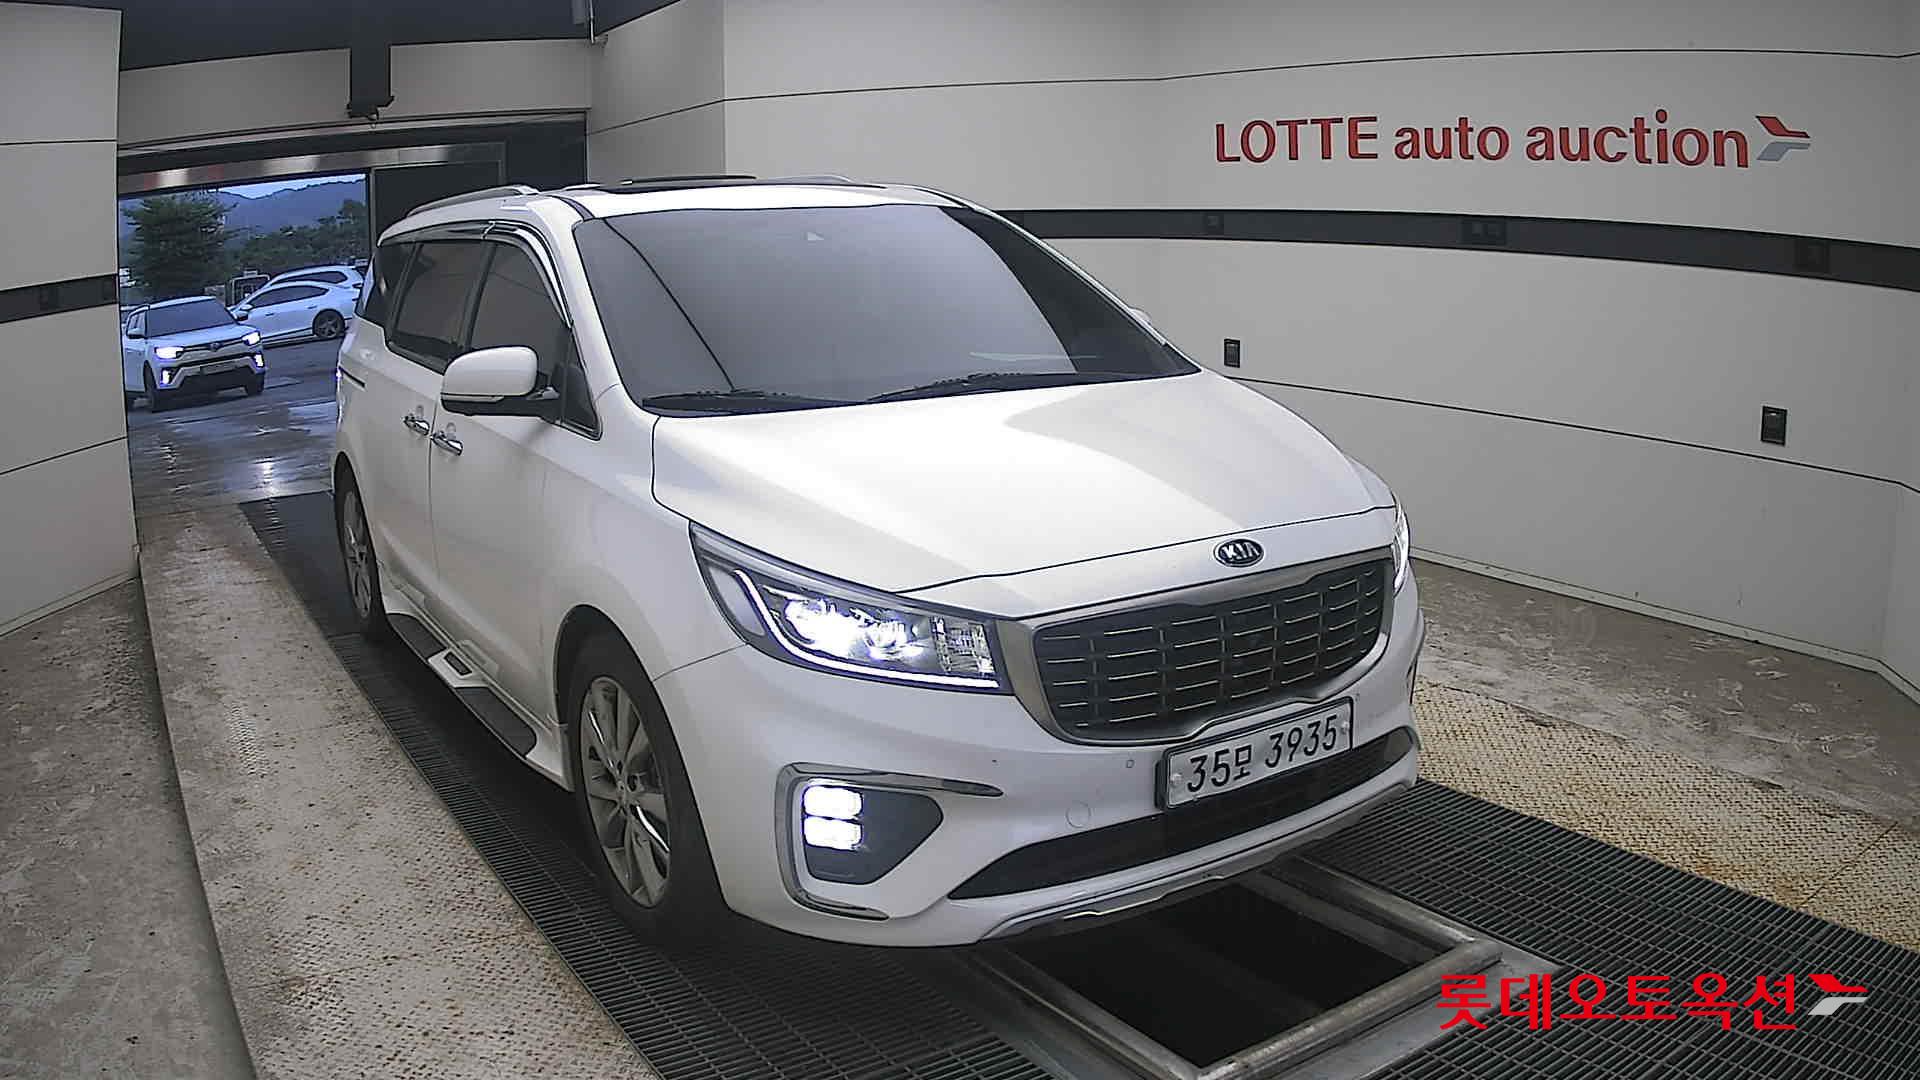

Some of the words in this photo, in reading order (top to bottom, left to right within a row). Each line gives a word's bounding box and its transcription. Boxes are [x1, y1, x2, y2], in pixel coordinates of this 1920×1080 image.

[1215, 116, 1378, 163] LOTTE
[1394, 117, 1510, 161] auto
[1526, 109, 1749, 168] auction
[1218, 540, 1260, 560] KIA
[1187, 744, 1252, 792] 35모
[1265, 715, 1337, 768] 3935
